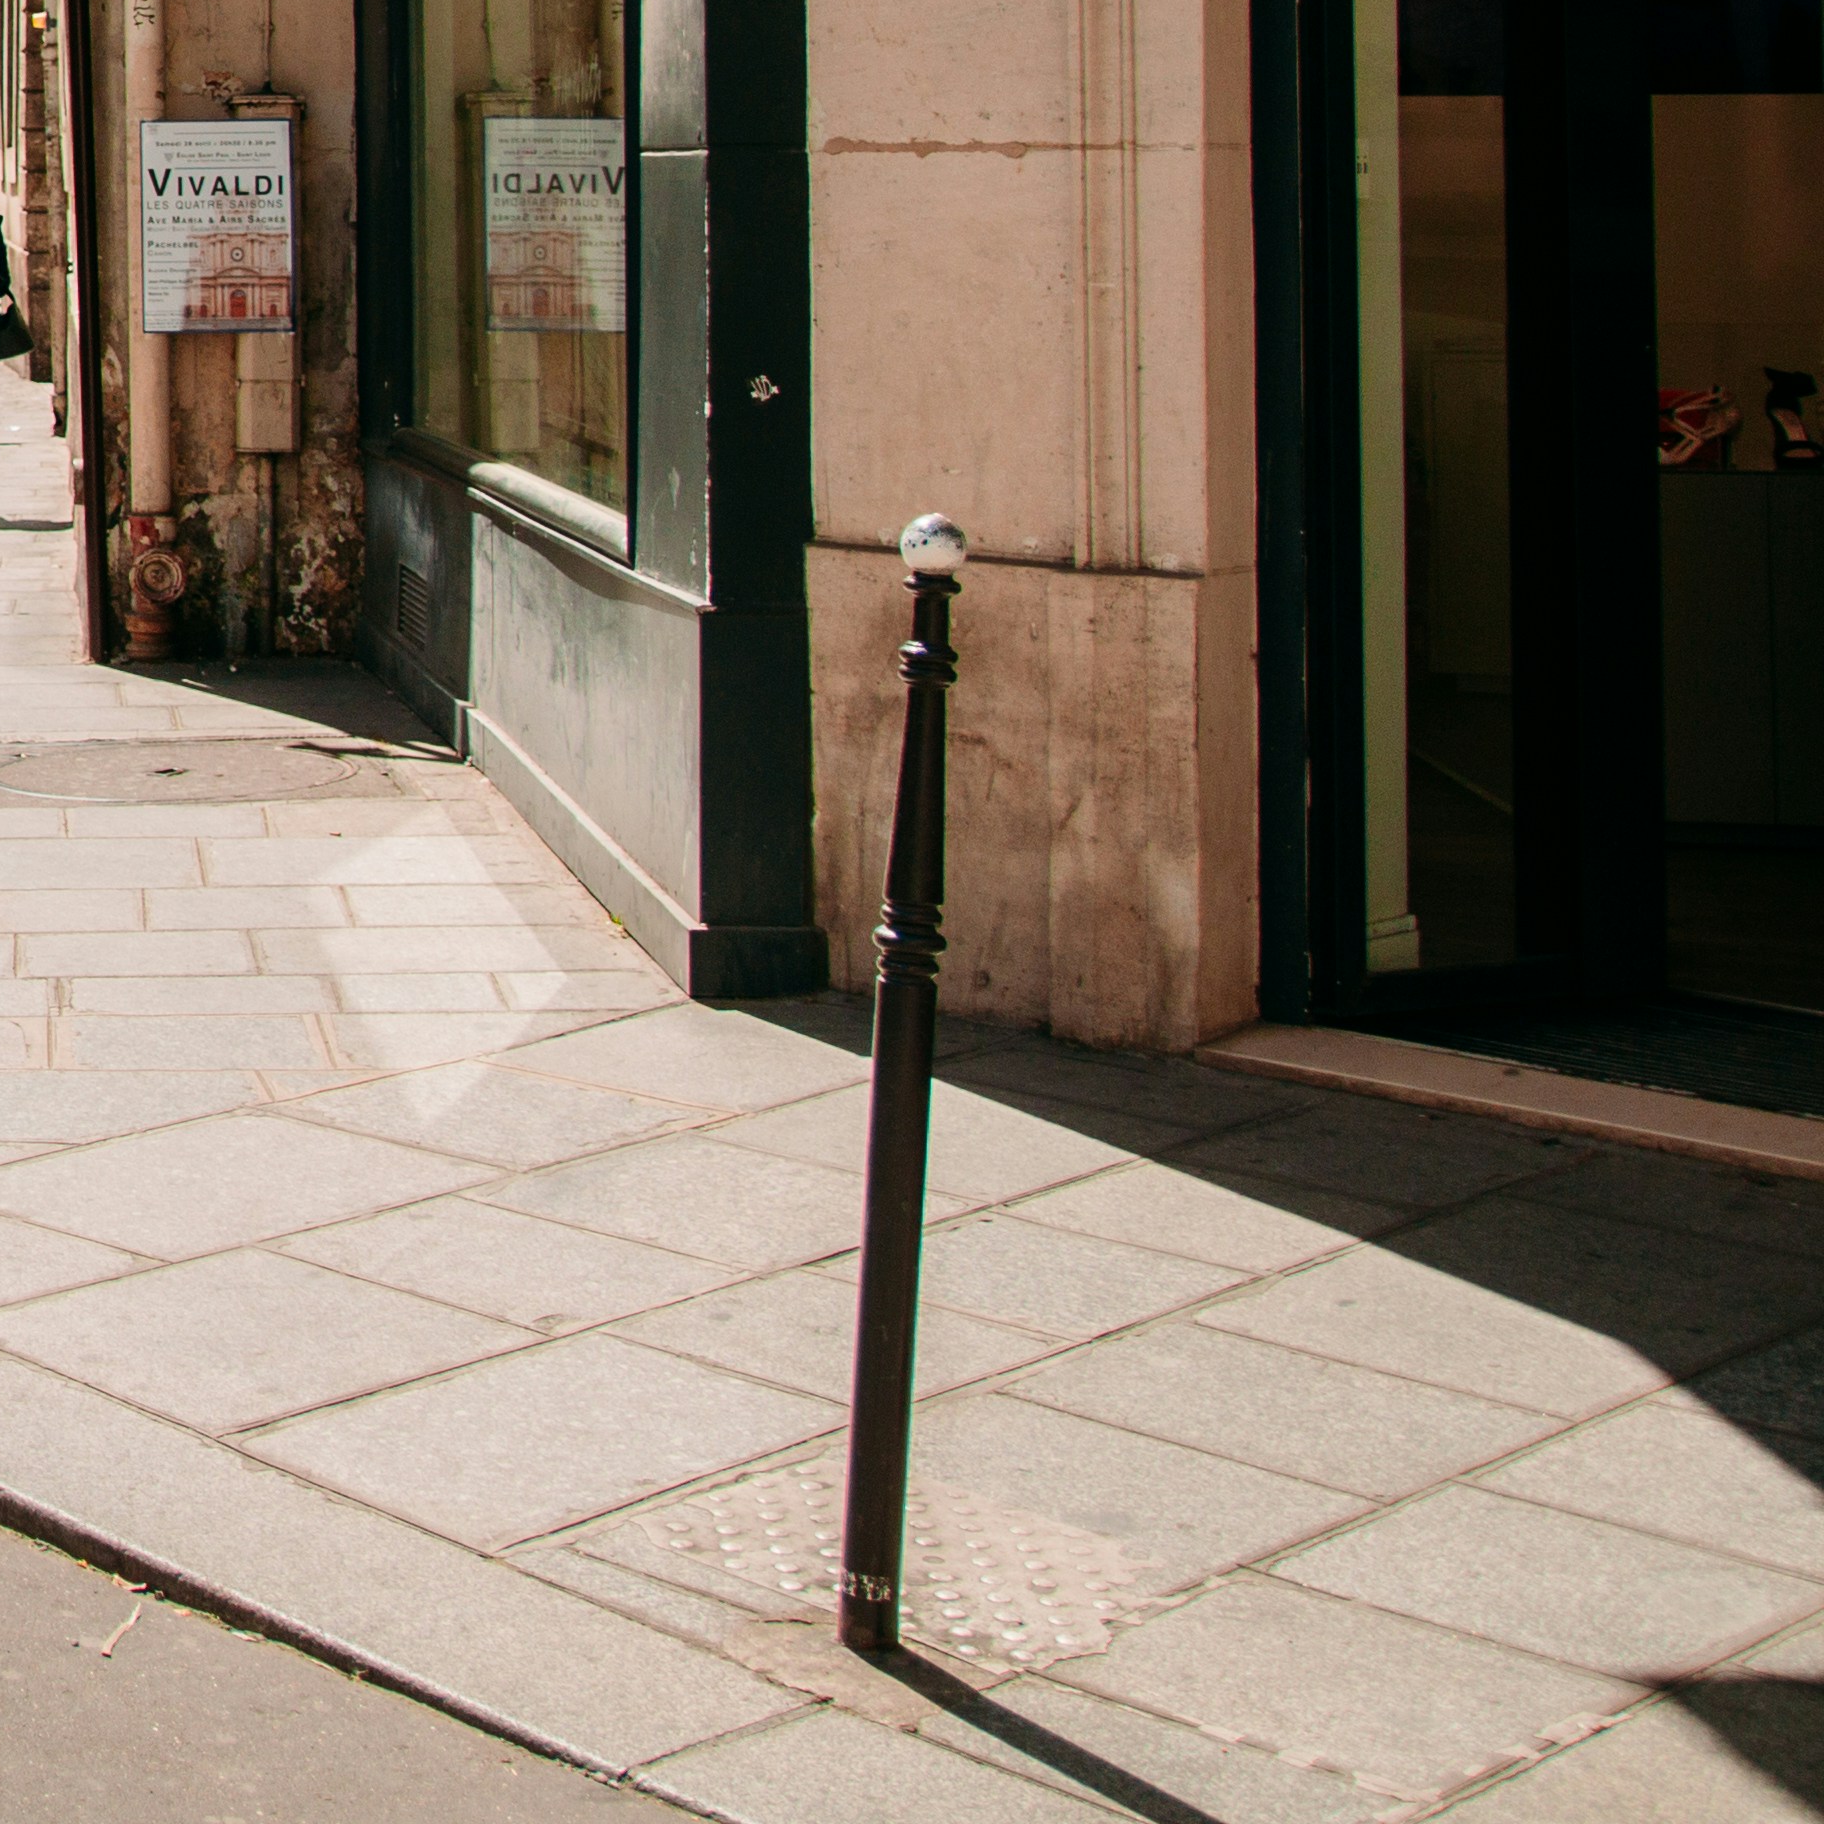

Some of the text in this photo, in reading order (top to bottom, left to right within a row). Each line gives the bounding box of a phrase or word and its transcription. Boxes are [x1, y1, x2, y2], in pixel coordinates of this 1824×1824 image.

[147, 168, 284, 197] VIVALDI
[147, 198, 284, 210] LES QUATRE SAISONS
[147, 216, 167, 224] AVE
[172, 215, 203, 224] MARIA
[219, 215, 243, 224] AIRS
